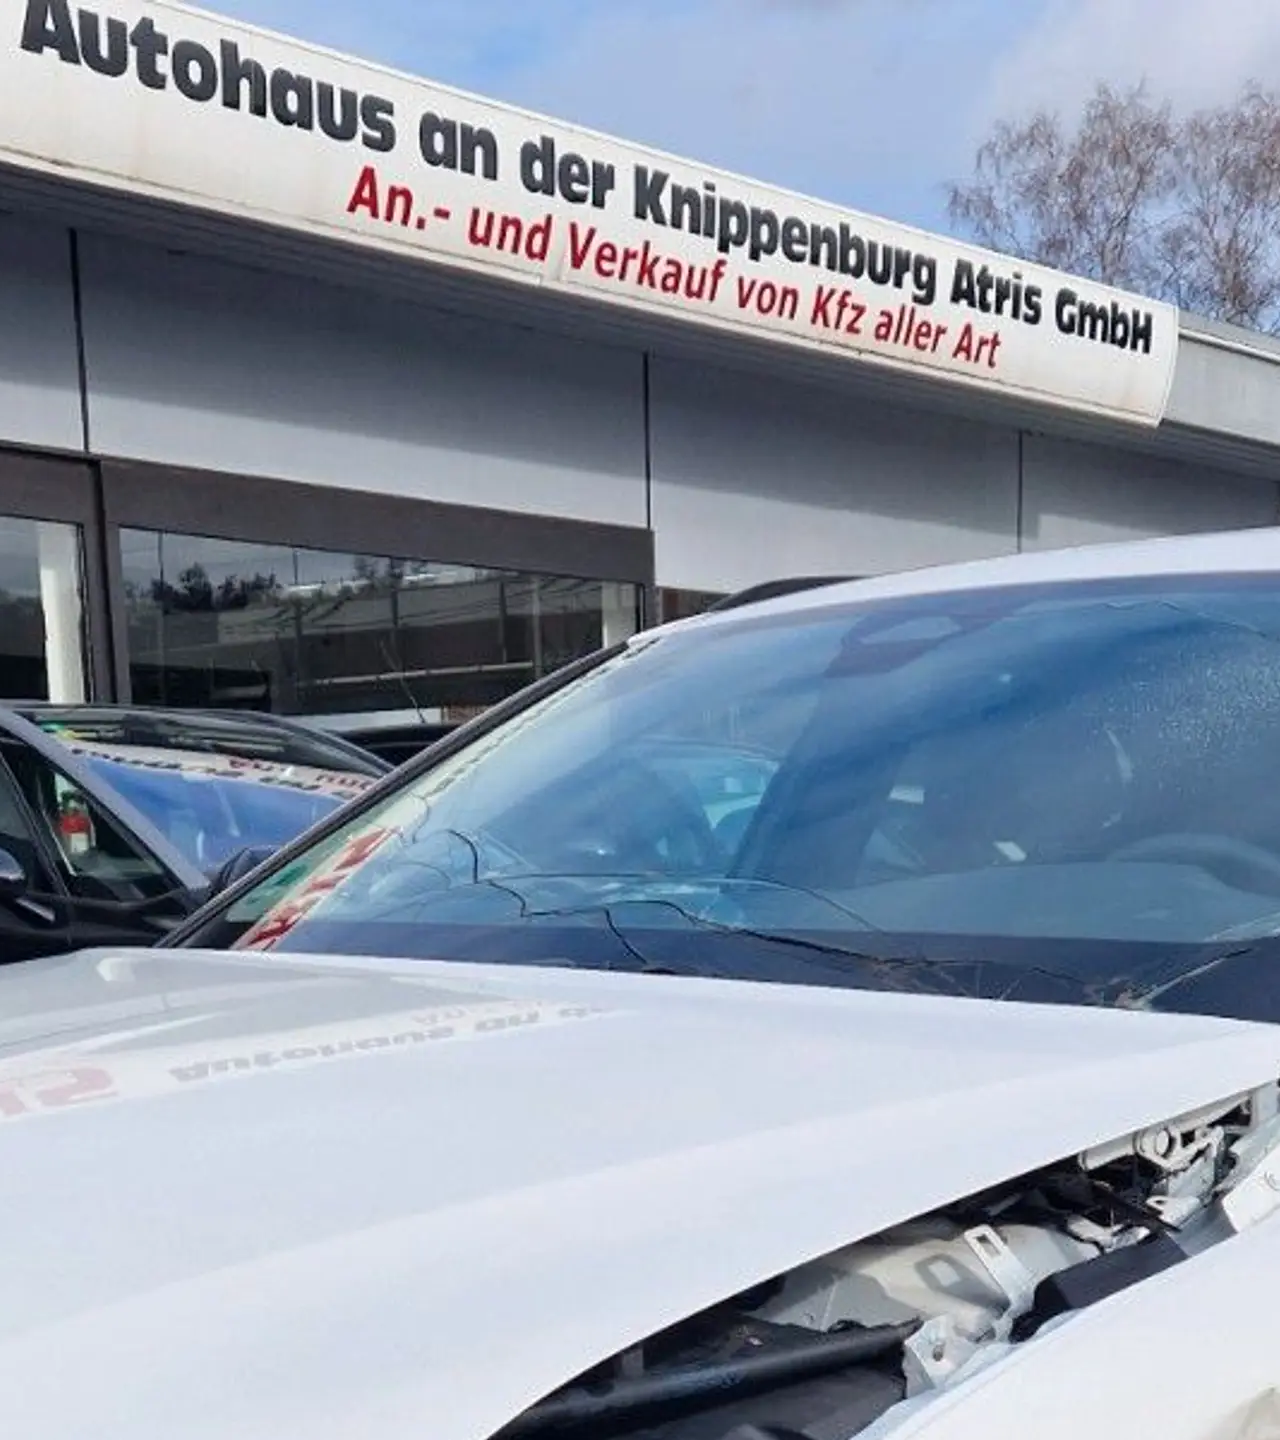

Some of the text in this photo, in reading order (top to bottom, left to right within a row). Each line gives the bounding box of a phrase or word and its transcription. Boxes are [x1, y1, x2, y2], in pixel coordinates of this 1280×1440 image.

[21, 0, 396, 153] Autohaus
[420, 110, 498, 181] an
[521, 136, 616, 209] der
[633, 162, 936, 306] Knippenburg
[951, 258, 1043, 325] Atris
[1056, 287, 1153, 354] GmbH
[468, 206, 553, 262] und
[569, 222, 725, 302] Verkauf
[737, 274, 799, 321] von
[811, 284, 867, 337] Kfz
[874, 304, 948, 355] aller
[952, 325, 1002, 369] Art
